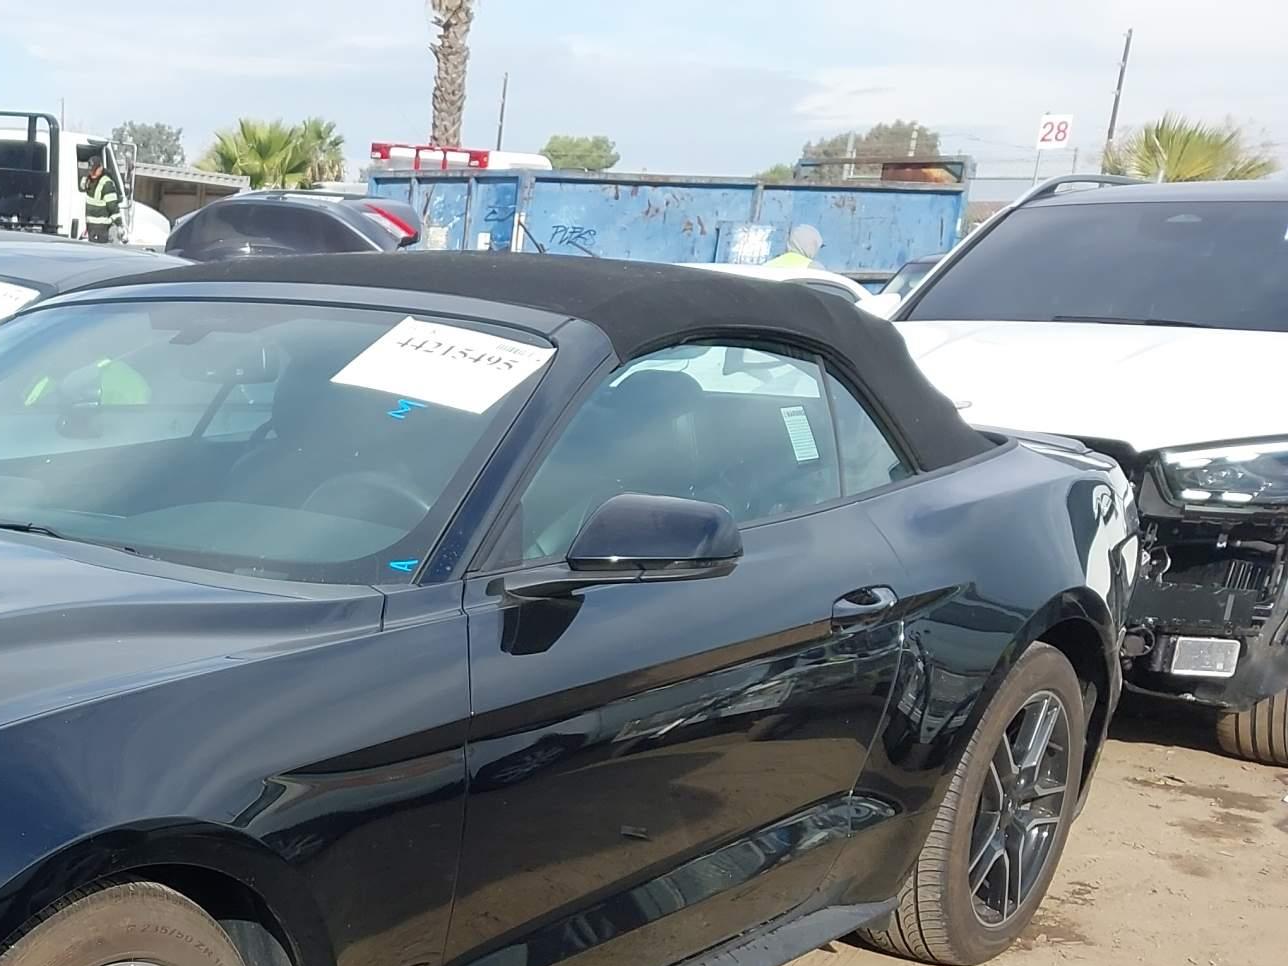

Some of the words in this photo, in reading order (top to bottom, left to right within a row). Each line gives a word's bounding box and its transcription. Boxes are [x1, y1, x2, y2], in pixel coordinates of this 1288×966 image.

[1039, 120, 1068, 142] 28
[397, 337, 520, 371] 44215495
[141, 923, 194, 944] 235/50
